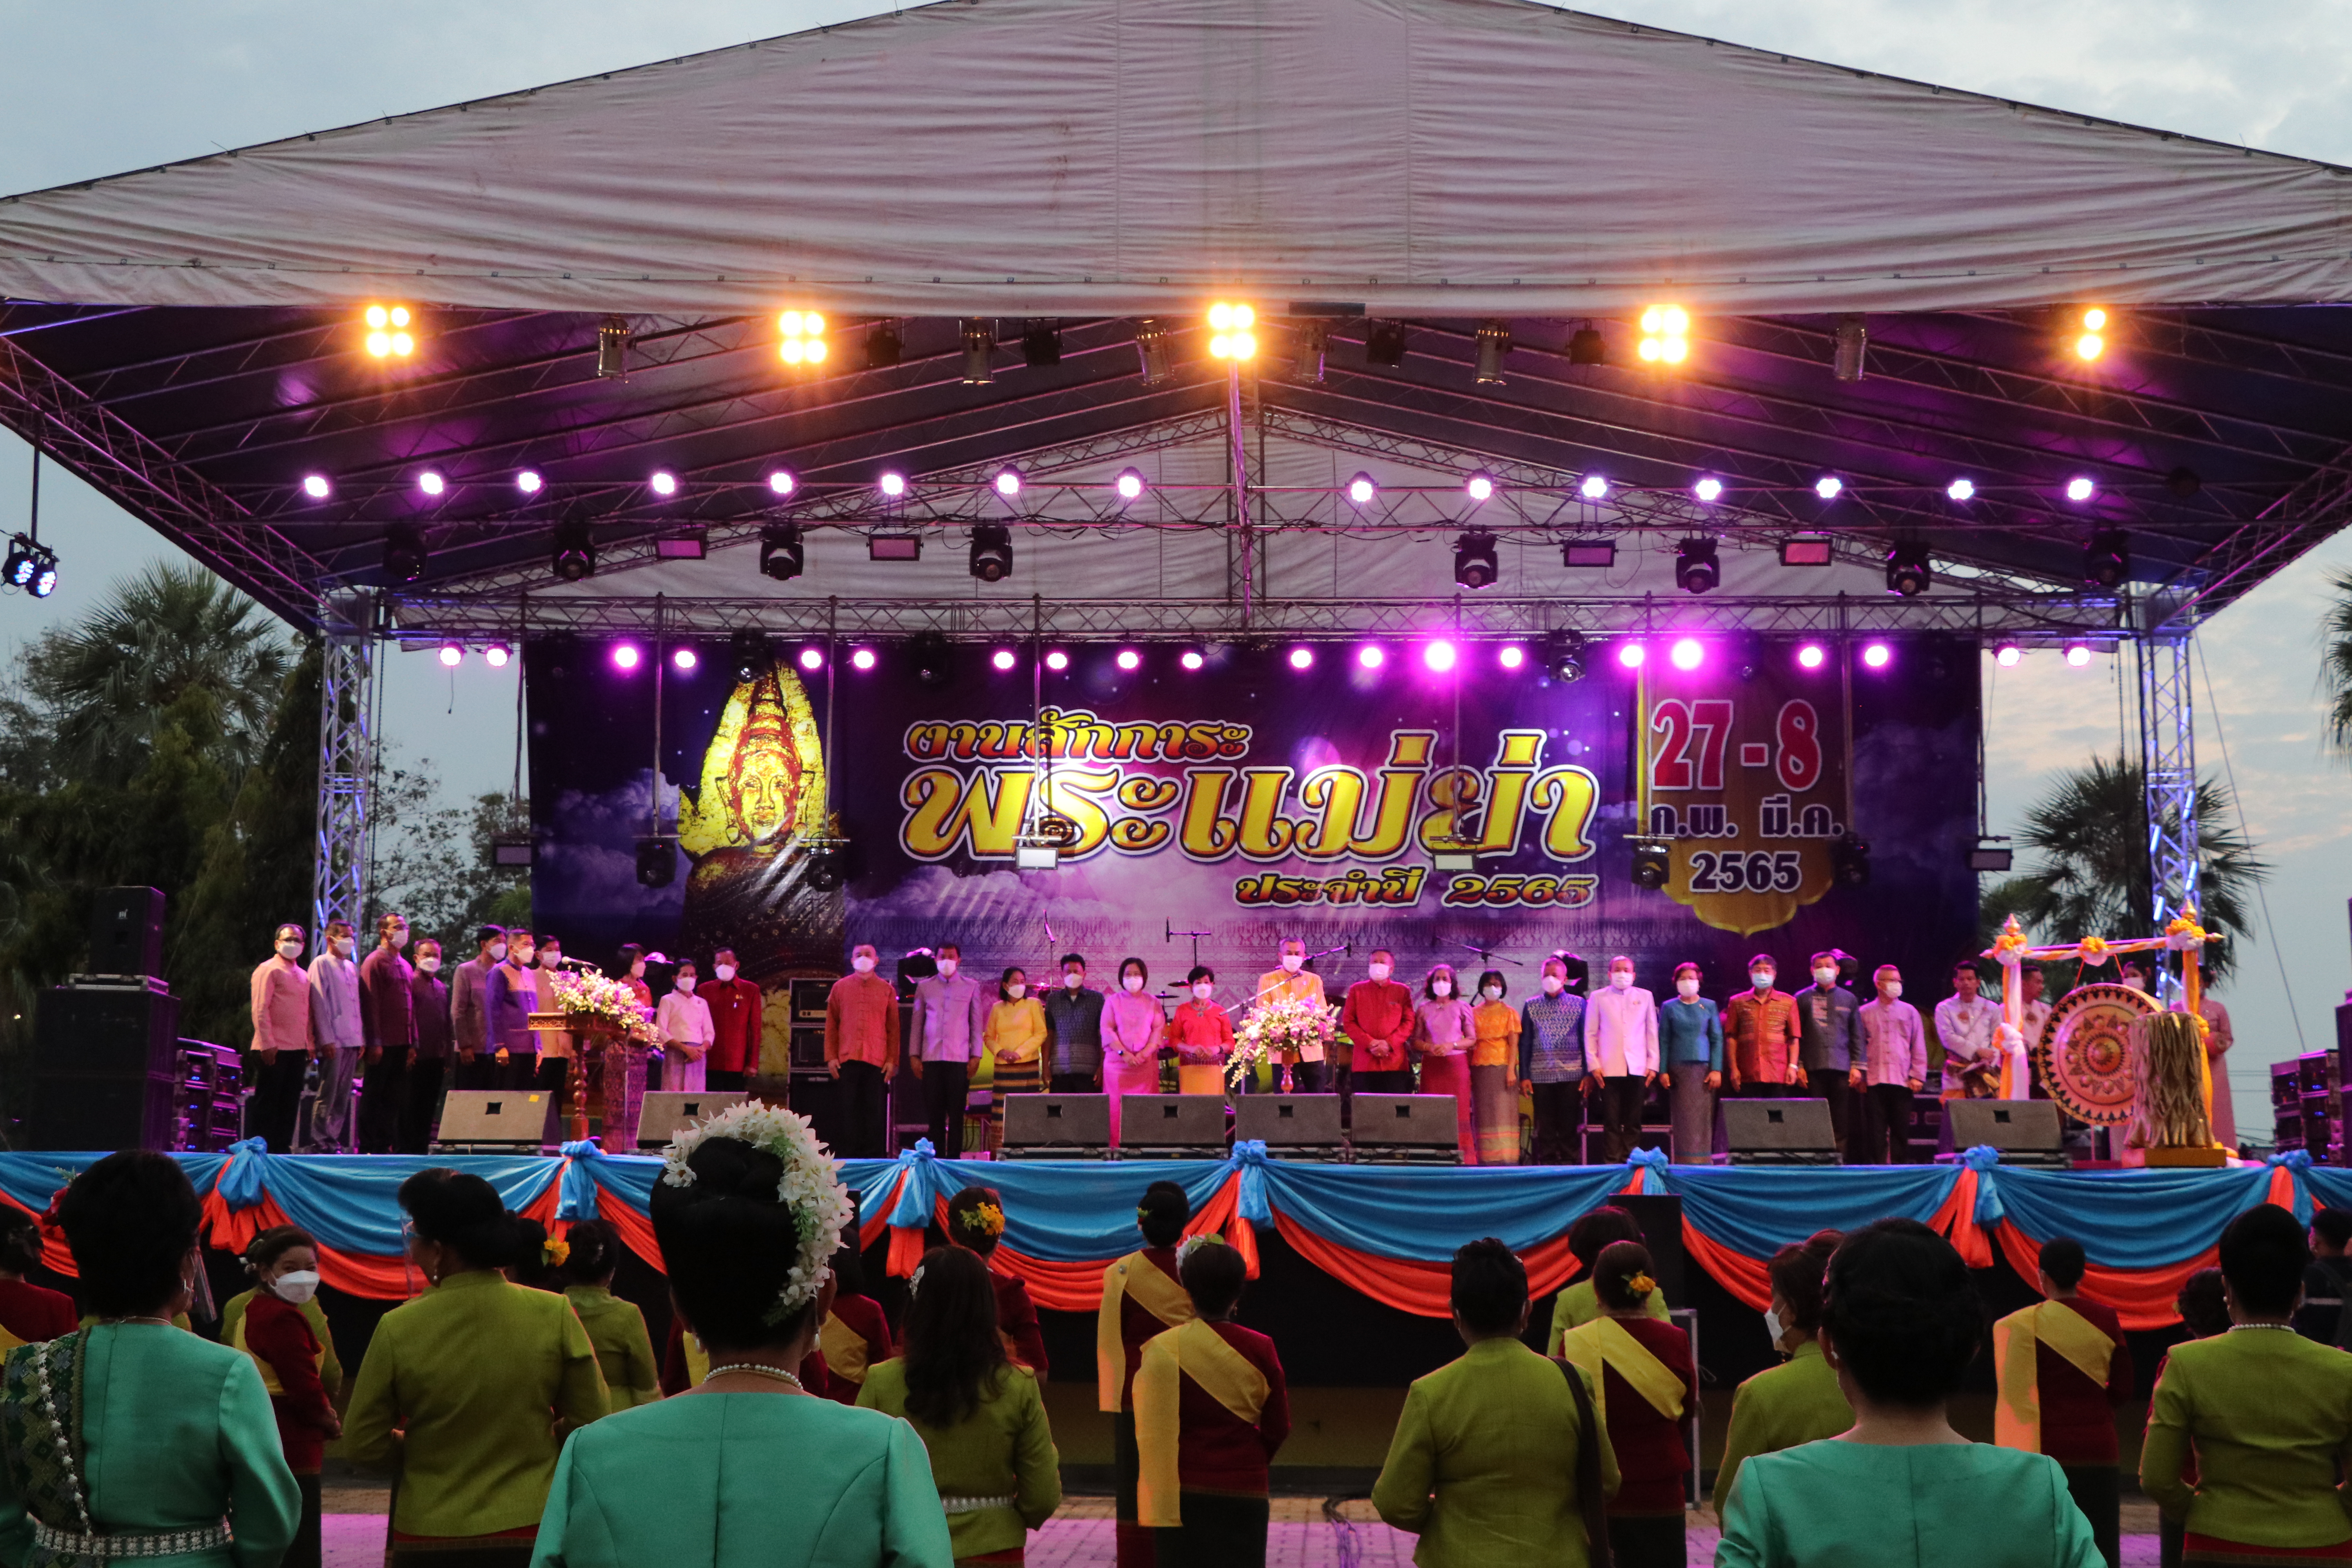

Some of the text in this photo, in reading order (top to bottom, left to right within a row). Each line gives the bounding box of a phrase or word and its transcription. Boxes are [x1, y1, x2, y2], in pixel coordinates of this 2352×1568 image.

[906, 707, 1251, 761] งานสักการะ
[901, 731, 1595, 860] พระแม่ย่า
[1651, 793, 1844, 838] ก.พ. มี.ค.
[1236, 865, 1597, 907] ประจำปี 2565
[1689, 850, 1802, 893] 2565
